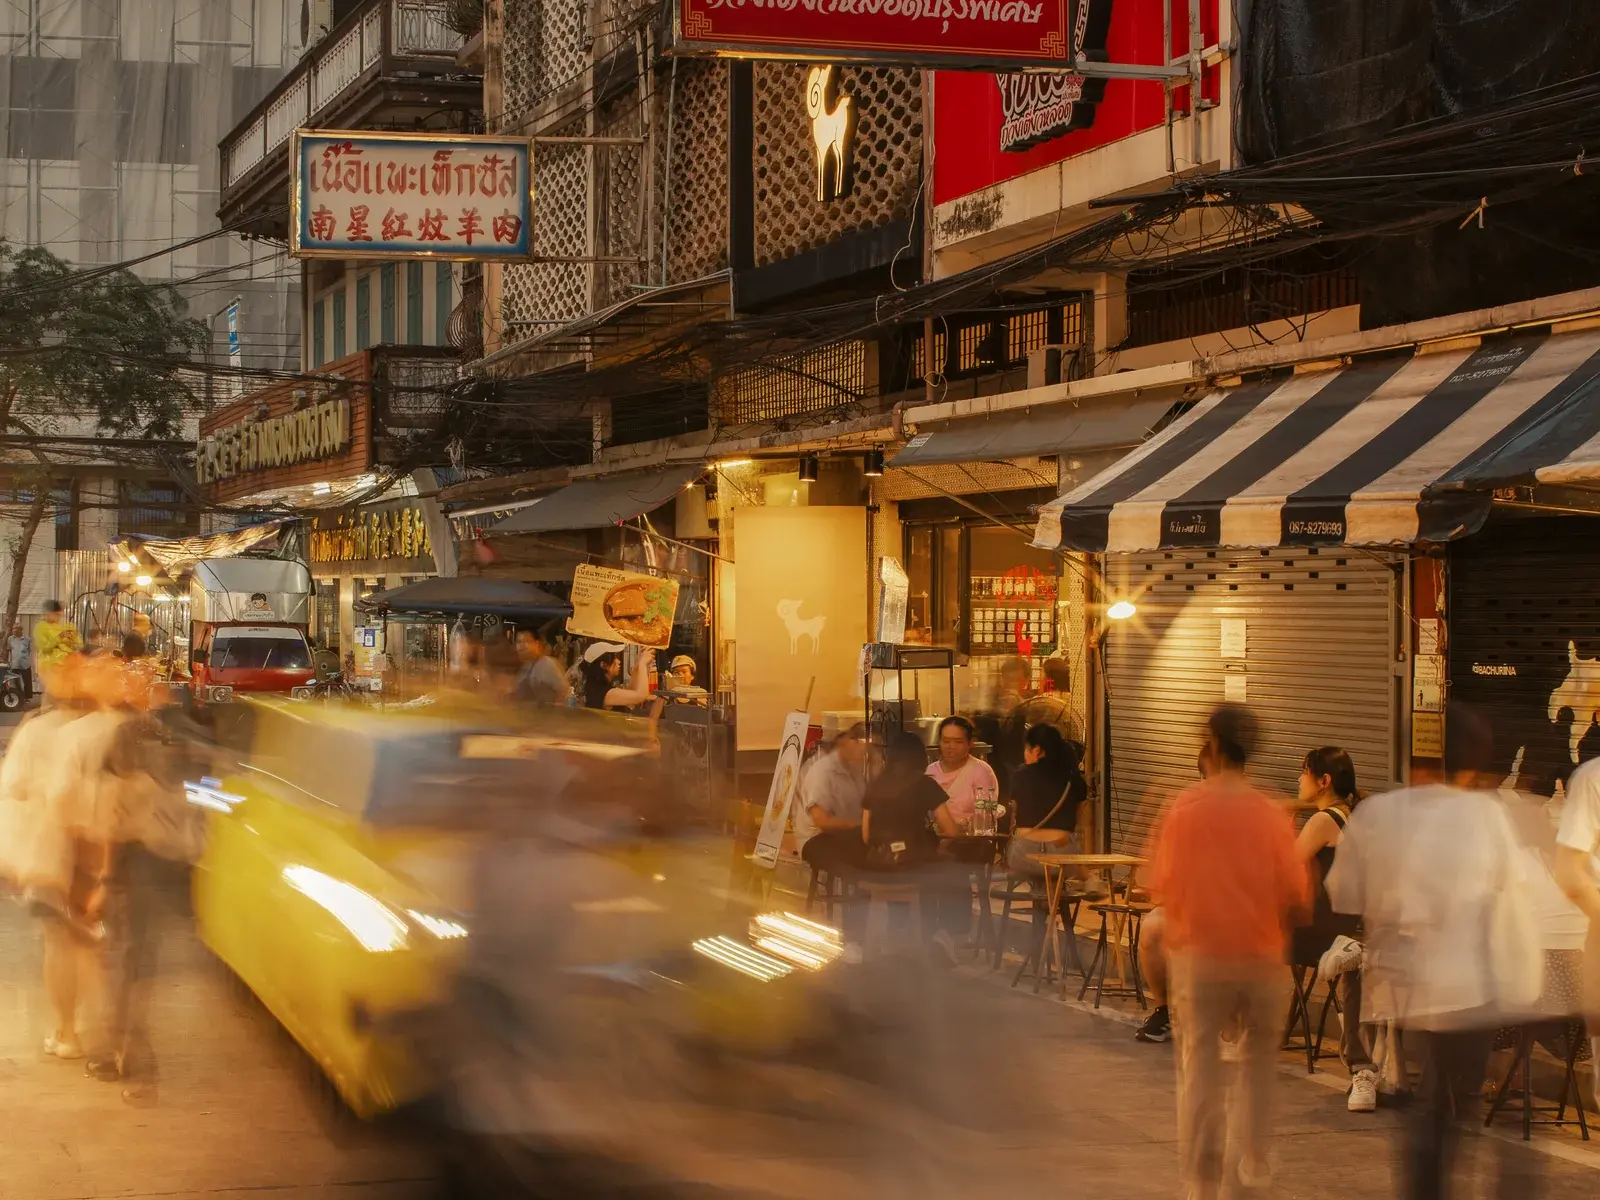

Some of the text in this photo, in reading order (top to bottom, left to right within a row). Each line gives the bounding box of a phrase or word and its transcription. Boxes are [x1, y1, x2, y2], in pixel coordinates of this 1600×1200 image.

[310, 140, 517, 198] เนื้อแพะเท็กซัส
[308, 204, 522, 245] 南星紅炆羊肉
